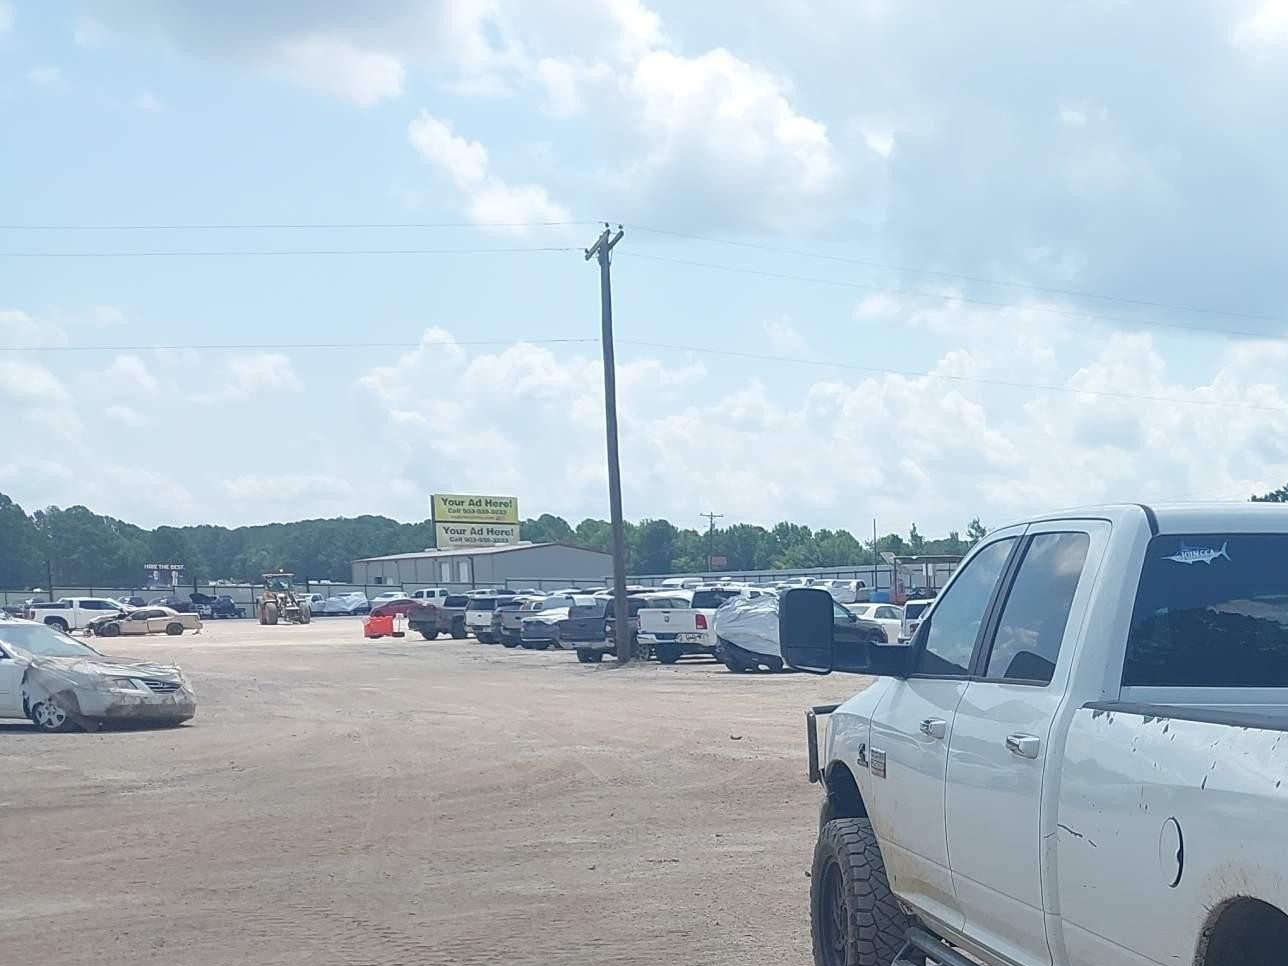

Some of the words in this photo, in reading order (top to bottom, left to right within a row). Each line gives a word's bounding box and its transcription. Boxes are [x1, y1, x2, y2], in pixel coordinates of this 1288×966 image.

[441, 498, 465, 507] Your
[468, 499, 482, 507] Ad
[485, 499, 513, 508] Here!
[442, 526, 466, 535] Your
[470, 527, 484, 535] Ad
[487, 528, 514, 536] Here!
